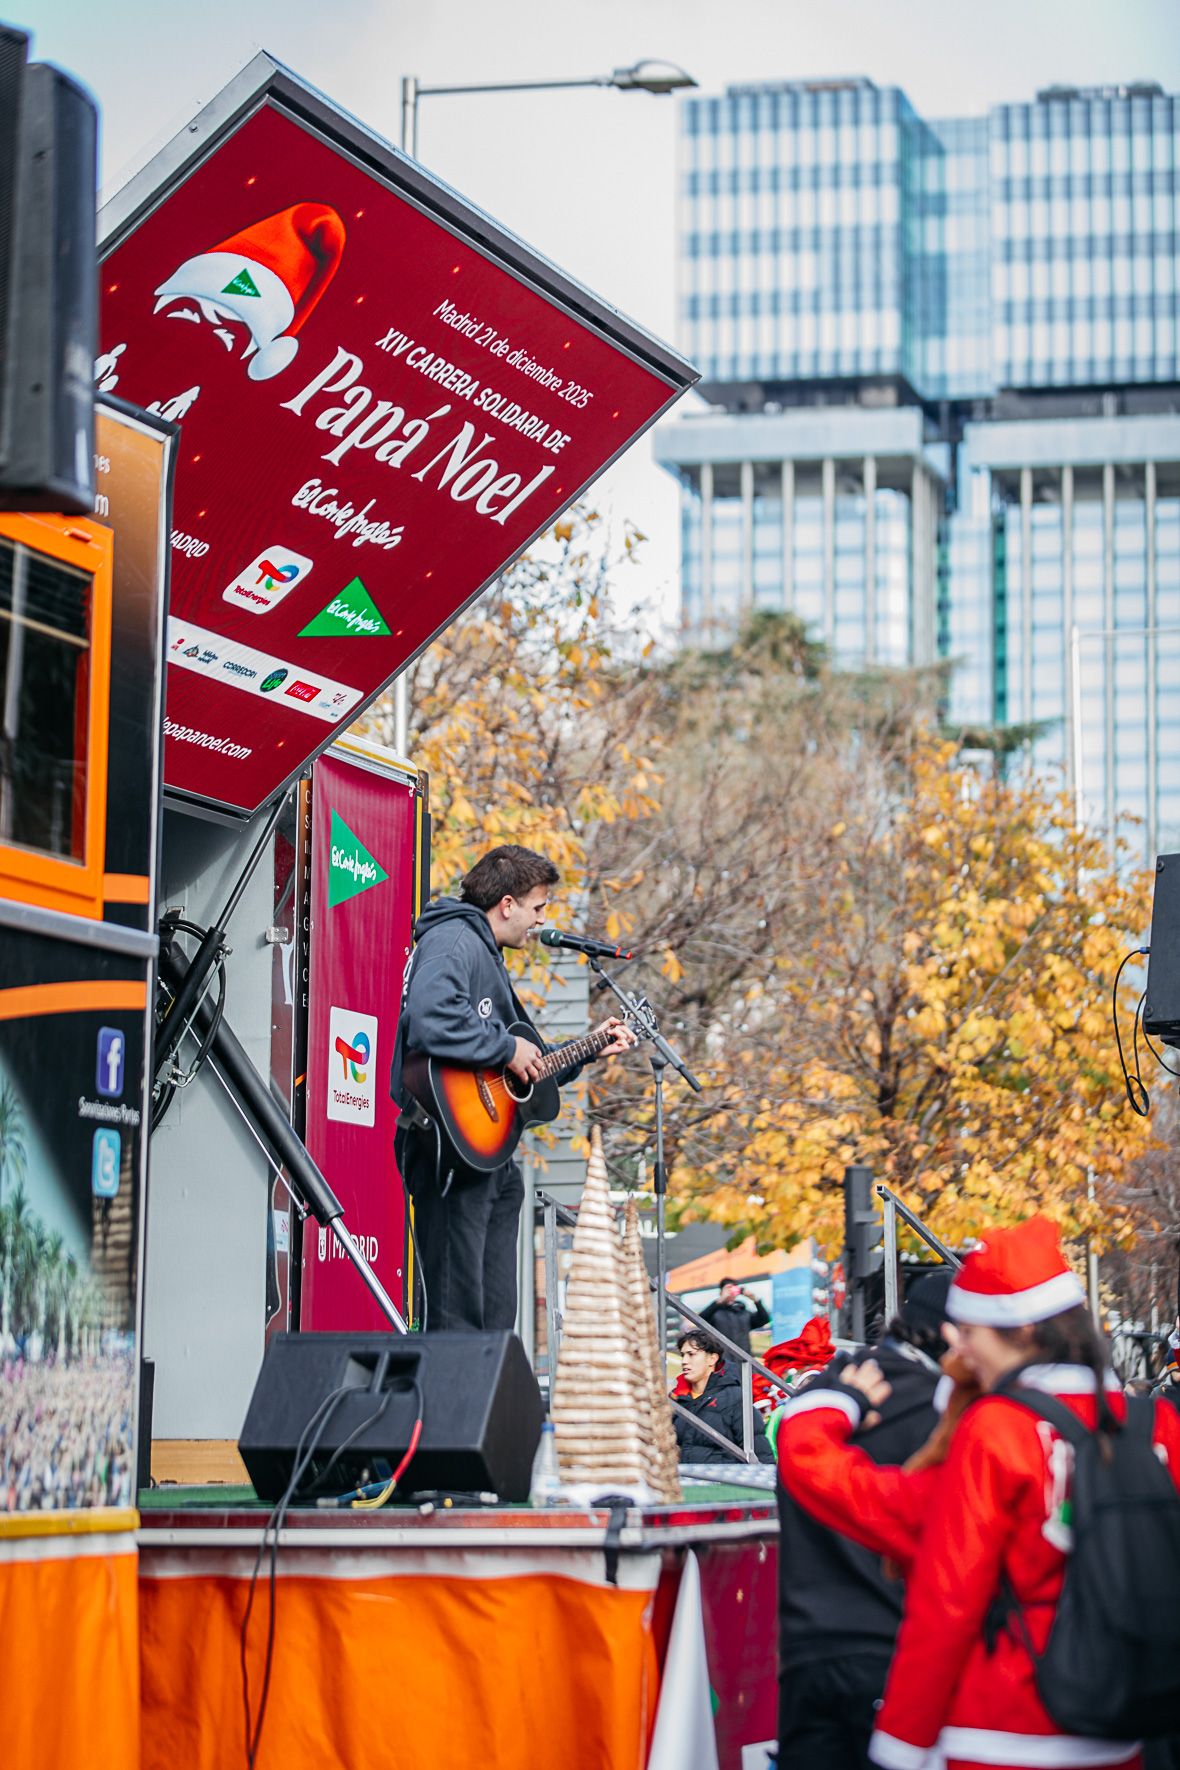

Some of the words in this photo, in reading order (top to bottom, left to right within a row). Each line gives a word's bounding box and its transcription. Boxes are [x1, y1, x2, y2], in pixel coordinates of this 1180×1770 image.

[375, 327, 415, 357] XIV
[405, 346, 480, 400] CARRERA
[473, 387, 550, 443] SOLIDARIA
[542, 429, 572, 454] DE
[433, 299, 484, 339] Madrid
[474, 327, 498, 347] 21
[490, 338, 510, 357] de
[505, 348, 563, 391] diciembre
[557, 381, 594, 409] 2025
[279, 345, 451, 469] Papá
[410, 420, 556, 526] Noel
[233, 584, 271, 606] TotalEnergies
[333, 1089, 370, 1111] TotalEnergies
